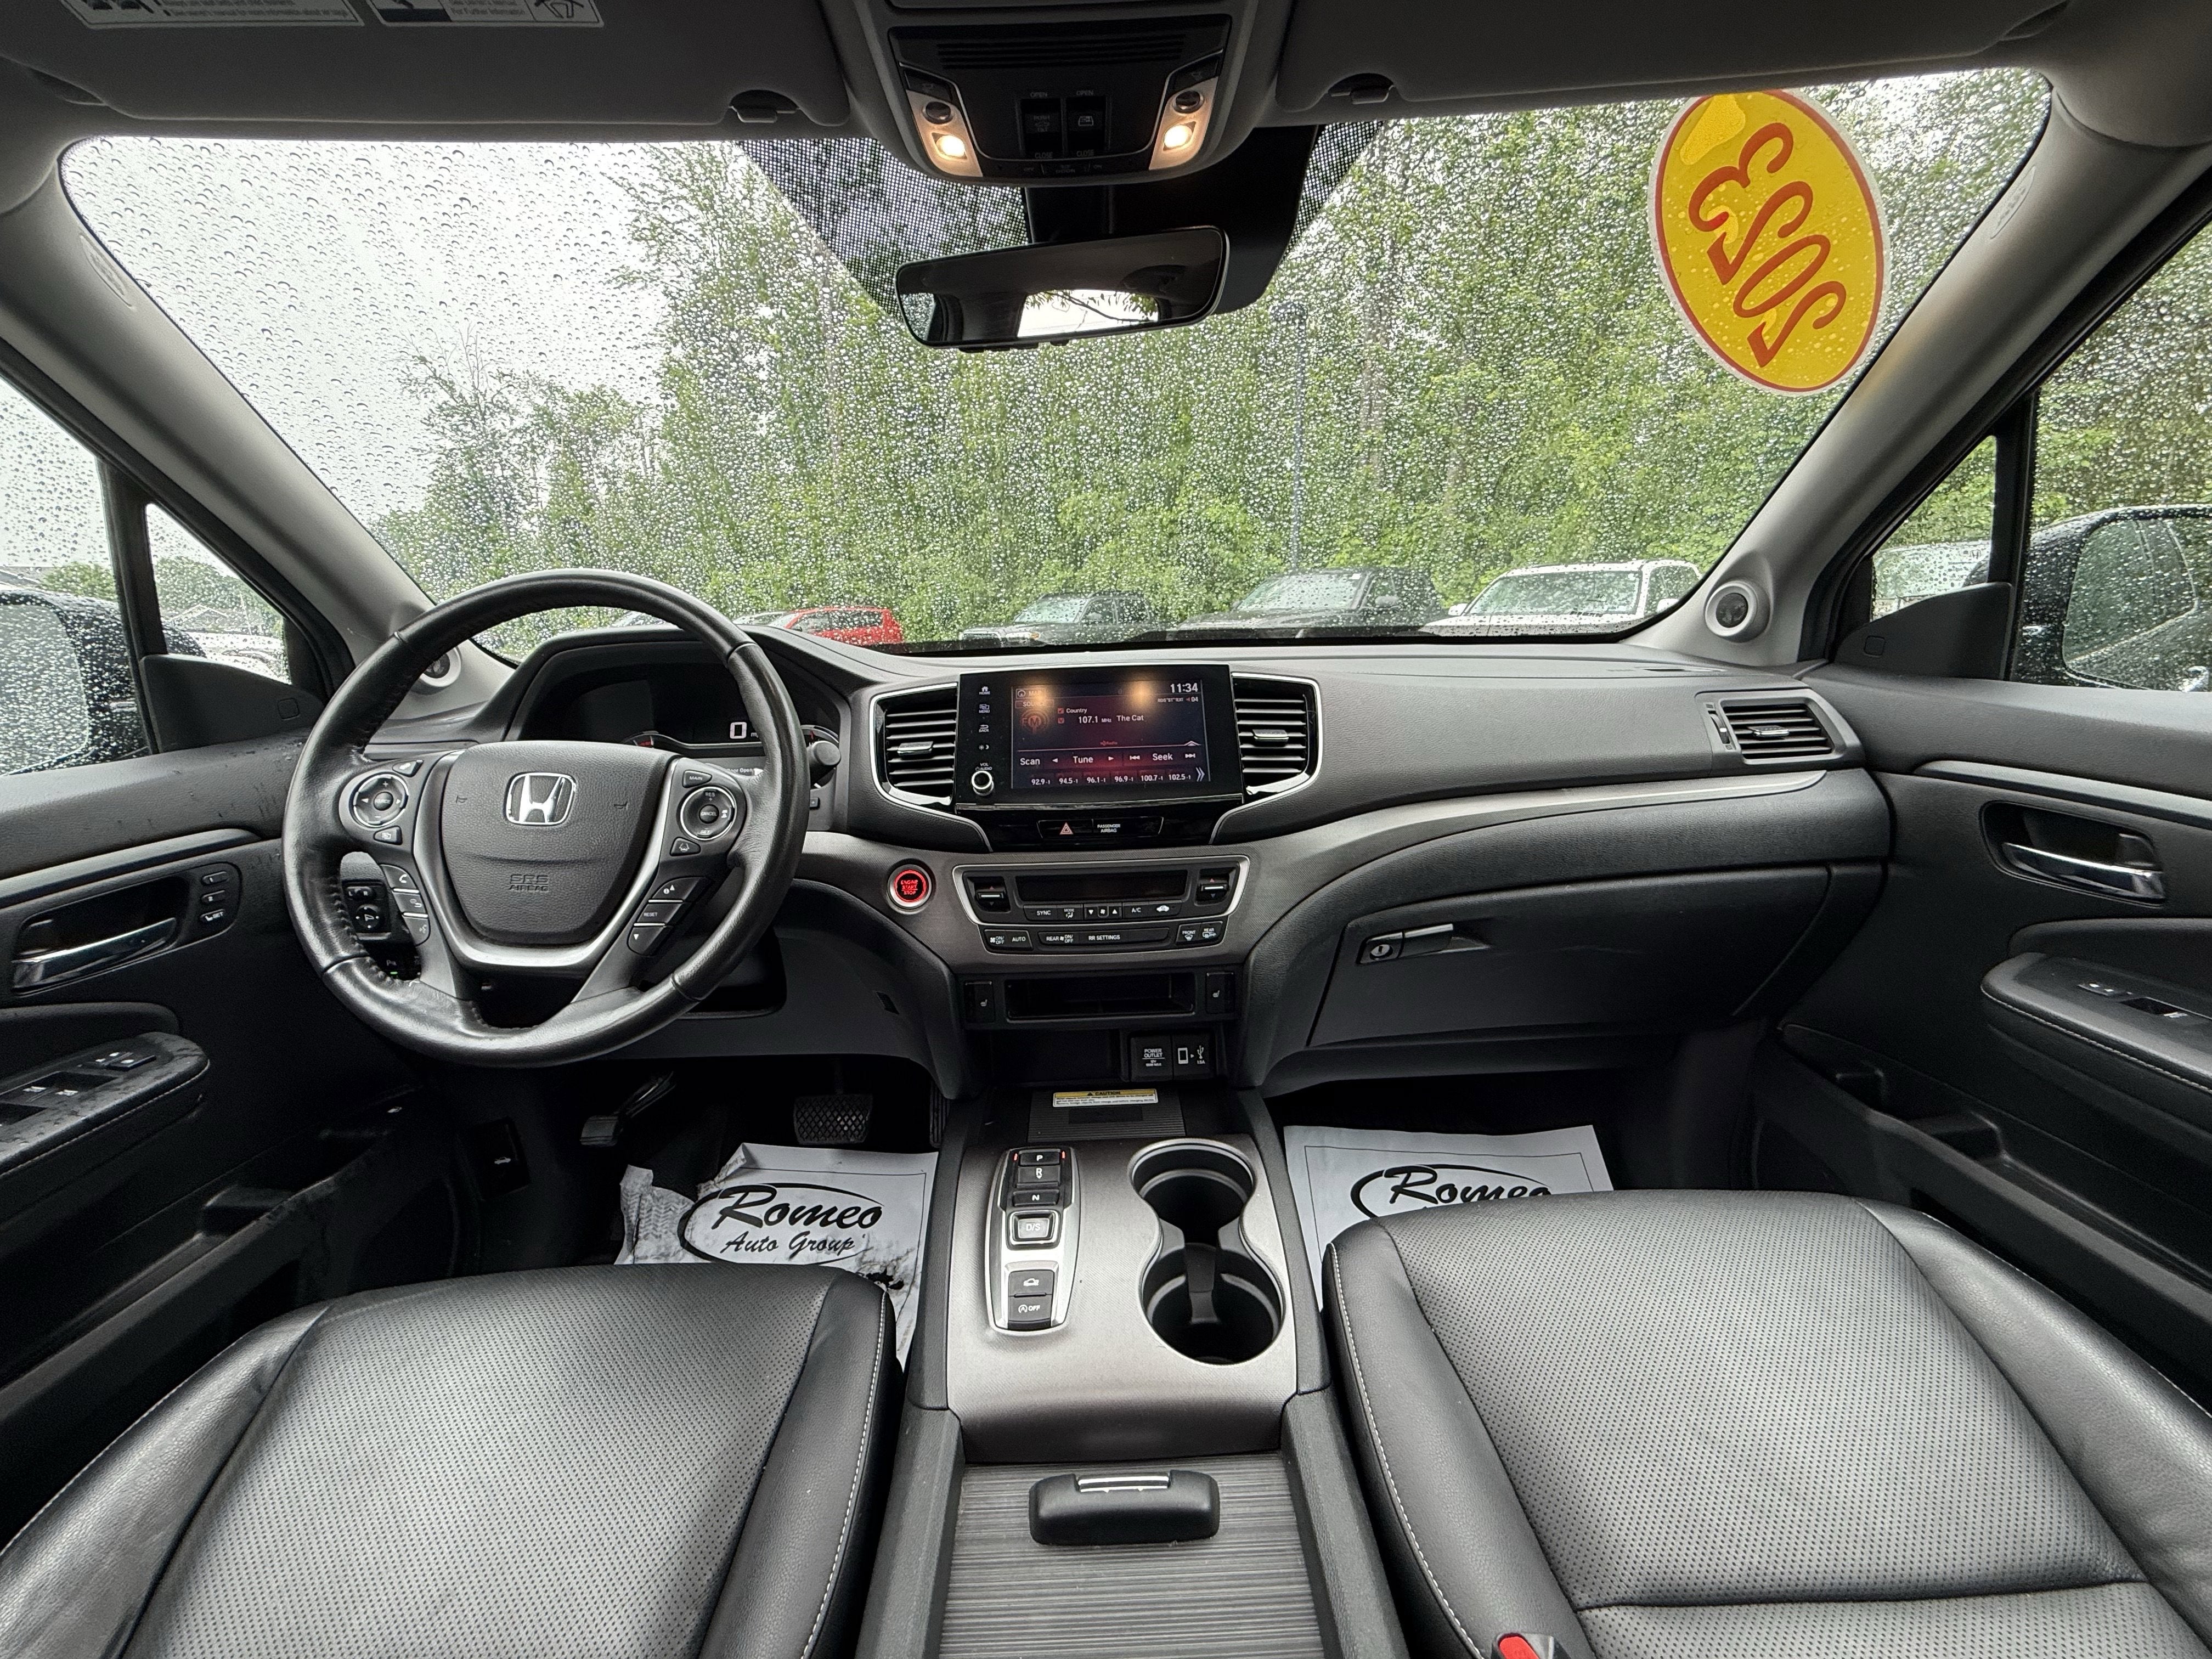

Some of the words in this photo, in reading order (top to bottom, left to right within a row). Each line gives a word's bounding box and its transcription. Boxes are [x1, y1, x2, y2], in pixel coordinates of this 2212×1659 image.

[1076, 149, 1094, 157] CLOSE
[1170, 682, 1199, 693] 11:34
[1078, 716, 1098, 724] 107.1
[730, 721, 747, 740] 0
[1073, 755, 1093, 764] Tune
[1152, 753, 1173, 761] Seek
[1020, 758, 1040, 766] Scan
[1036, 1167, 1042, 1176] R
[711, 1184, 883, 1230] Romeo
[1026, 1223, 1041, 1232] D/S
[720, 1231, 779, 1254] Auto
[788, 1231, 856, 1260] Group
